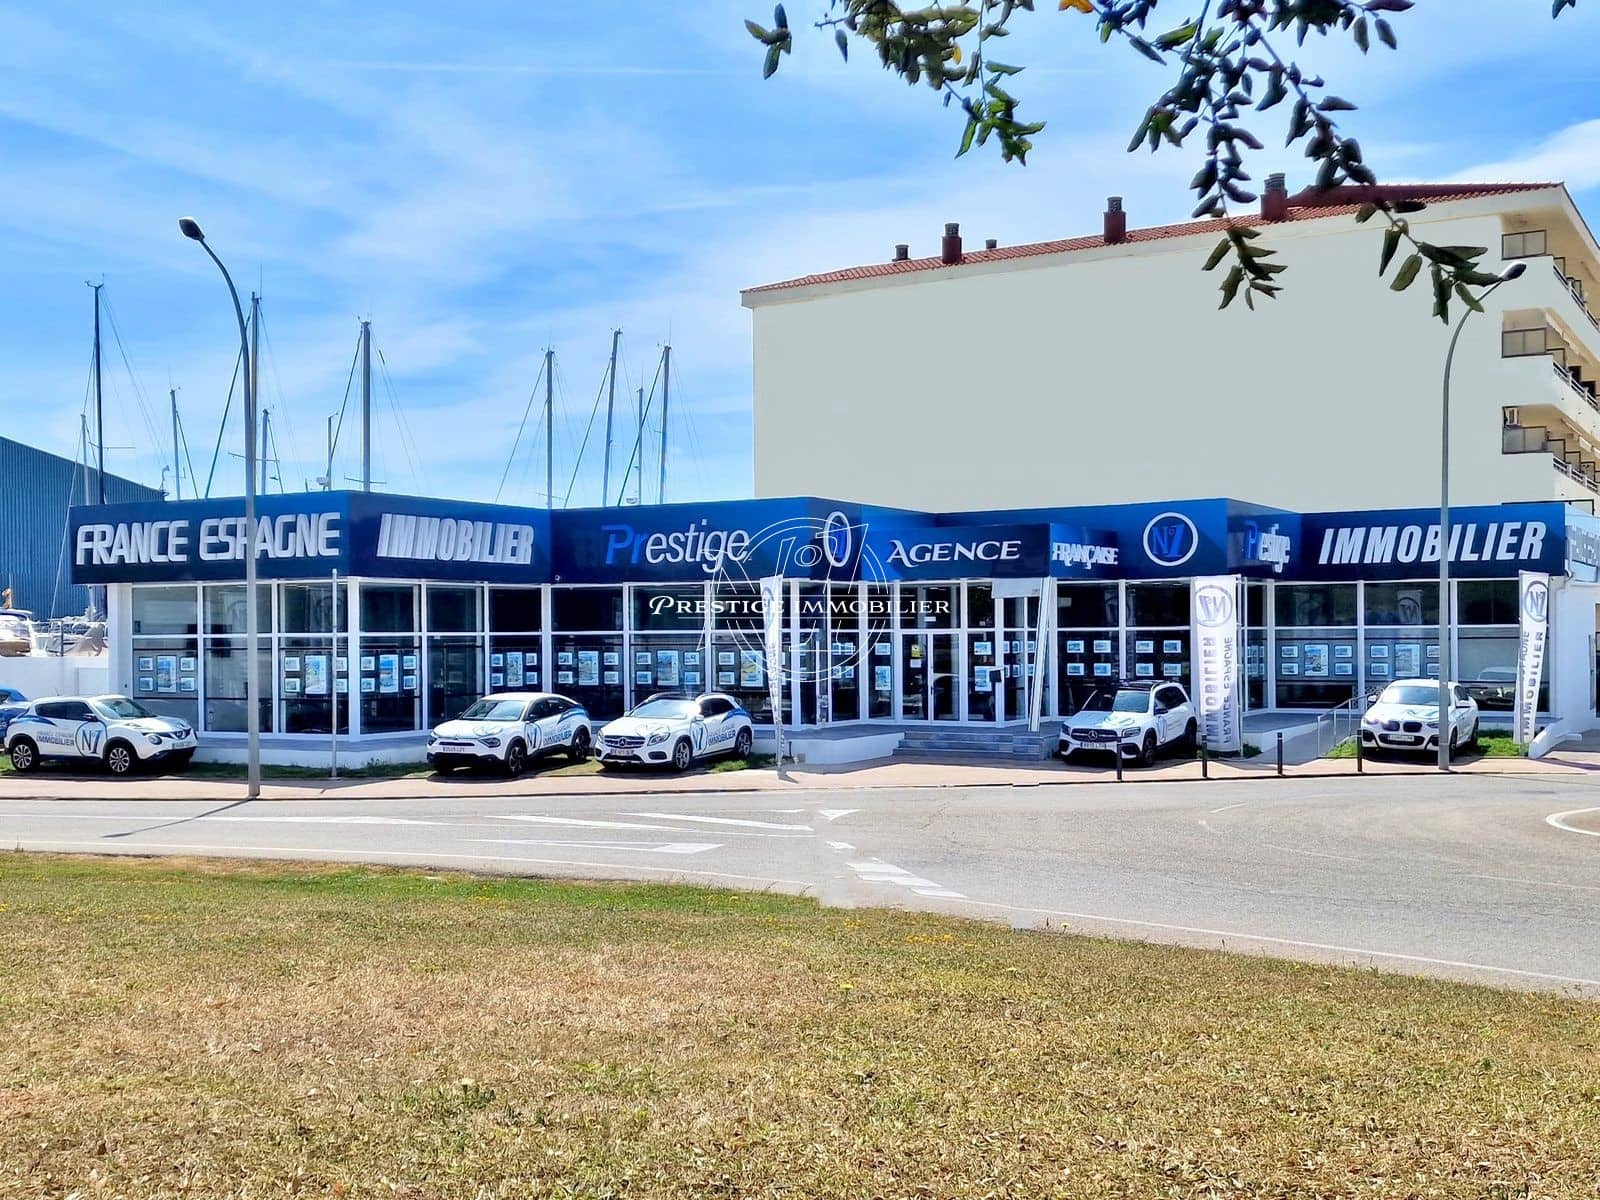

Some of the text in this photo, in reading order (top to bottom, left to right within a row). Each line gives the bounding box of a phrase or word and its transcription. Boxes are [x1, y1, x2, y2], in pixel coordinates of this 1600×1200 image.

[76, 512, 341, 565] FRANCE ESPAGNE
[376, 513, 534, 564] IMMOBILIER
[602, 518, 750, 573] Prestige
[886, 539, 1022, 568] AGENCE
[1318, 521, 1546, 565] IMMOBILIER
